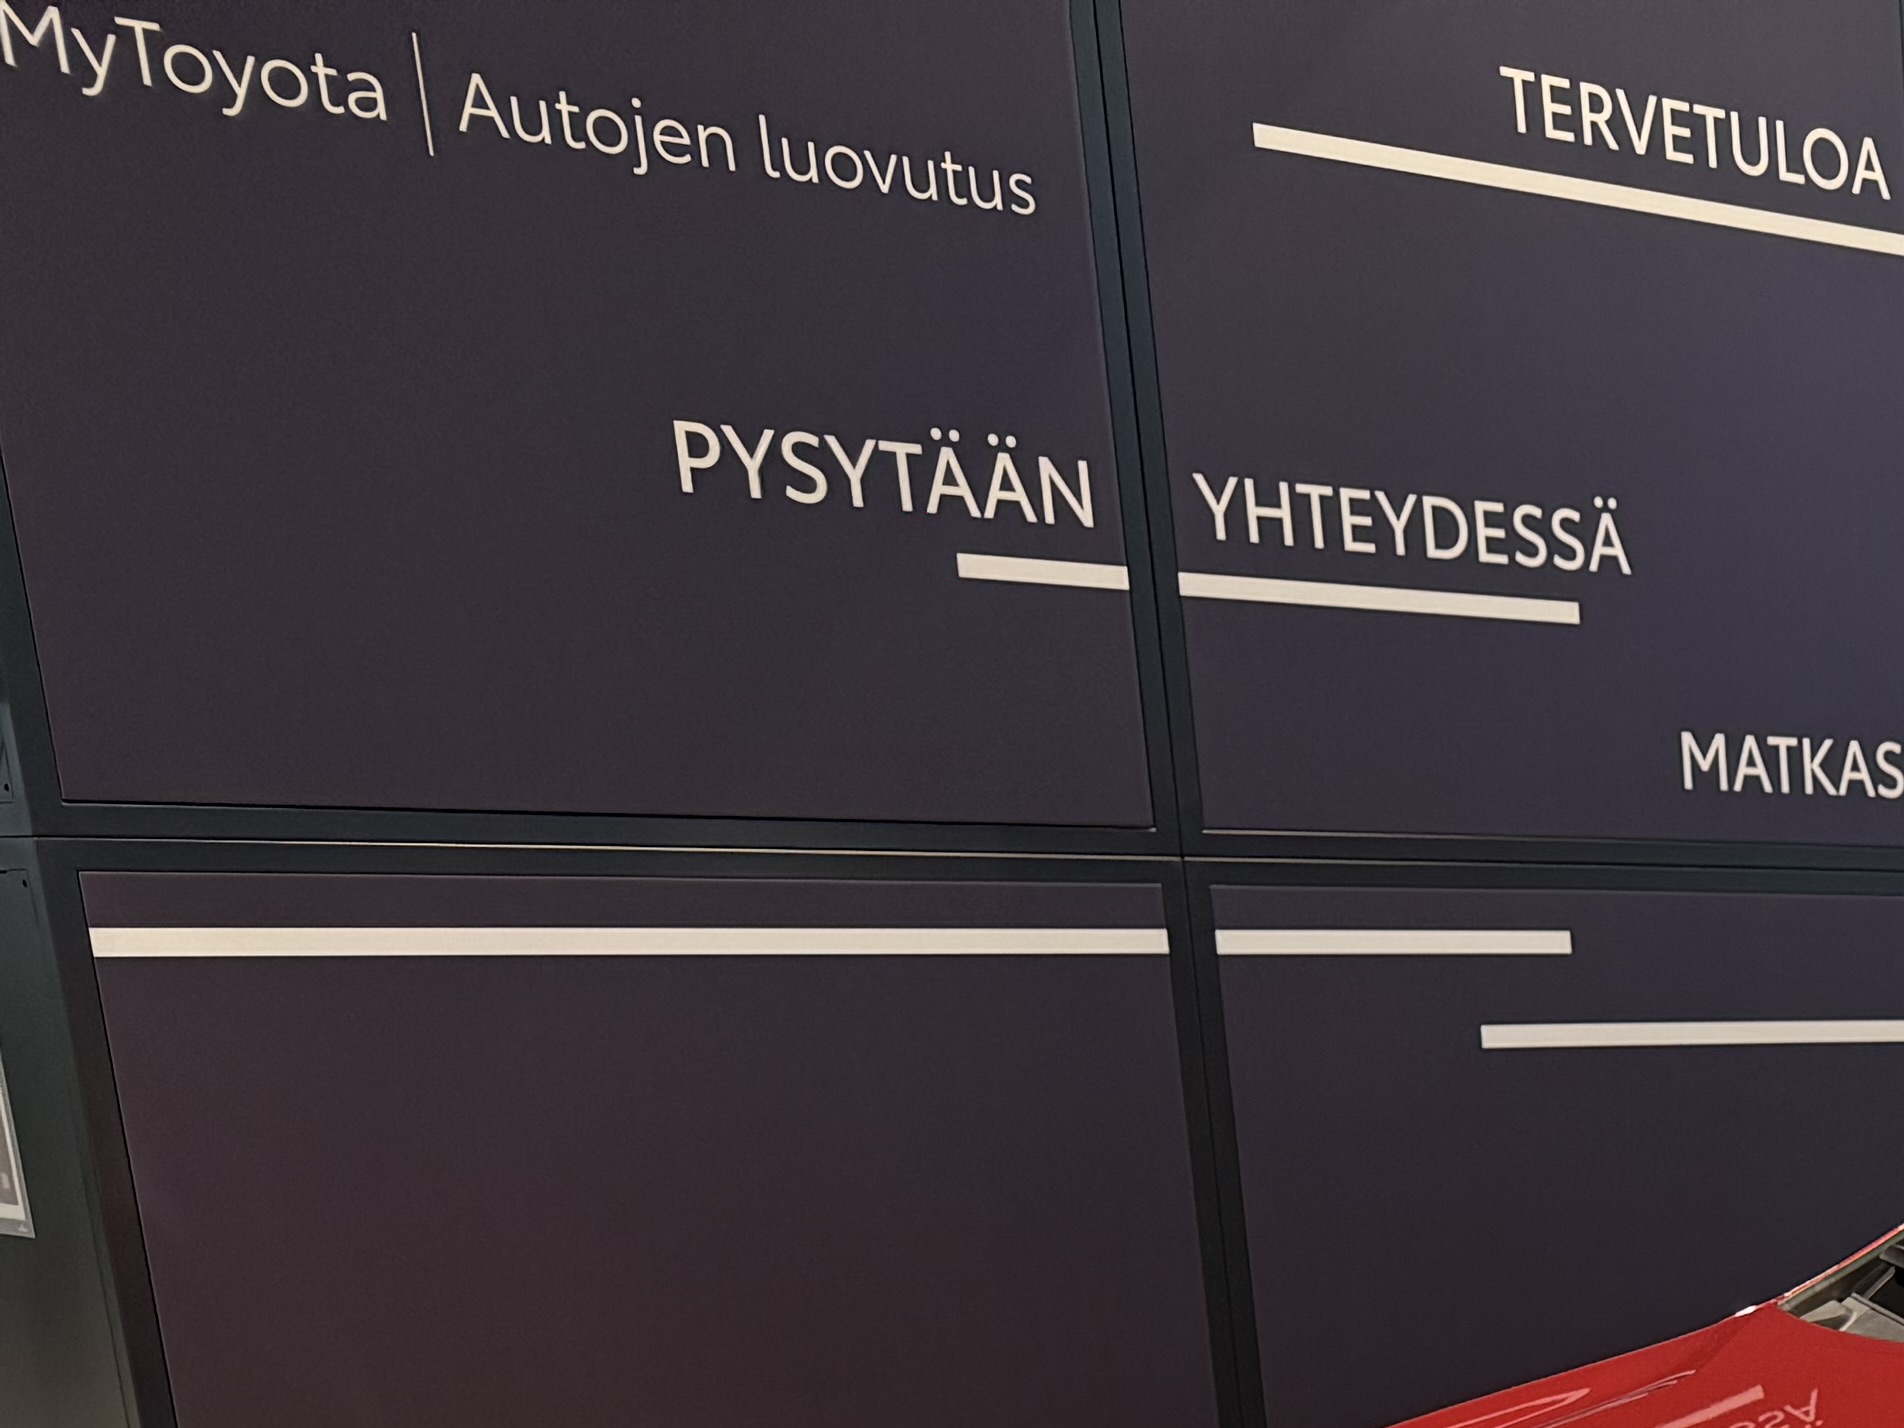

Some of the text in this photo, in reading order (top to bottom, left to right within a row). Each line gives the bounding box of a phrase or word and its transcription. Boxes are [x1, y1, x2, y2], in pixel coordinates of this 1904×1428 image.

[0, 0, 1036, 215] MyToyota Autojen luovutus
[1499, 65, 1891, 201] TERVETULOA
[673, 419, 1095, 528] PYSYTÄÄN
[1192, 471, 1632, 576] YHTEYDESSÄ
